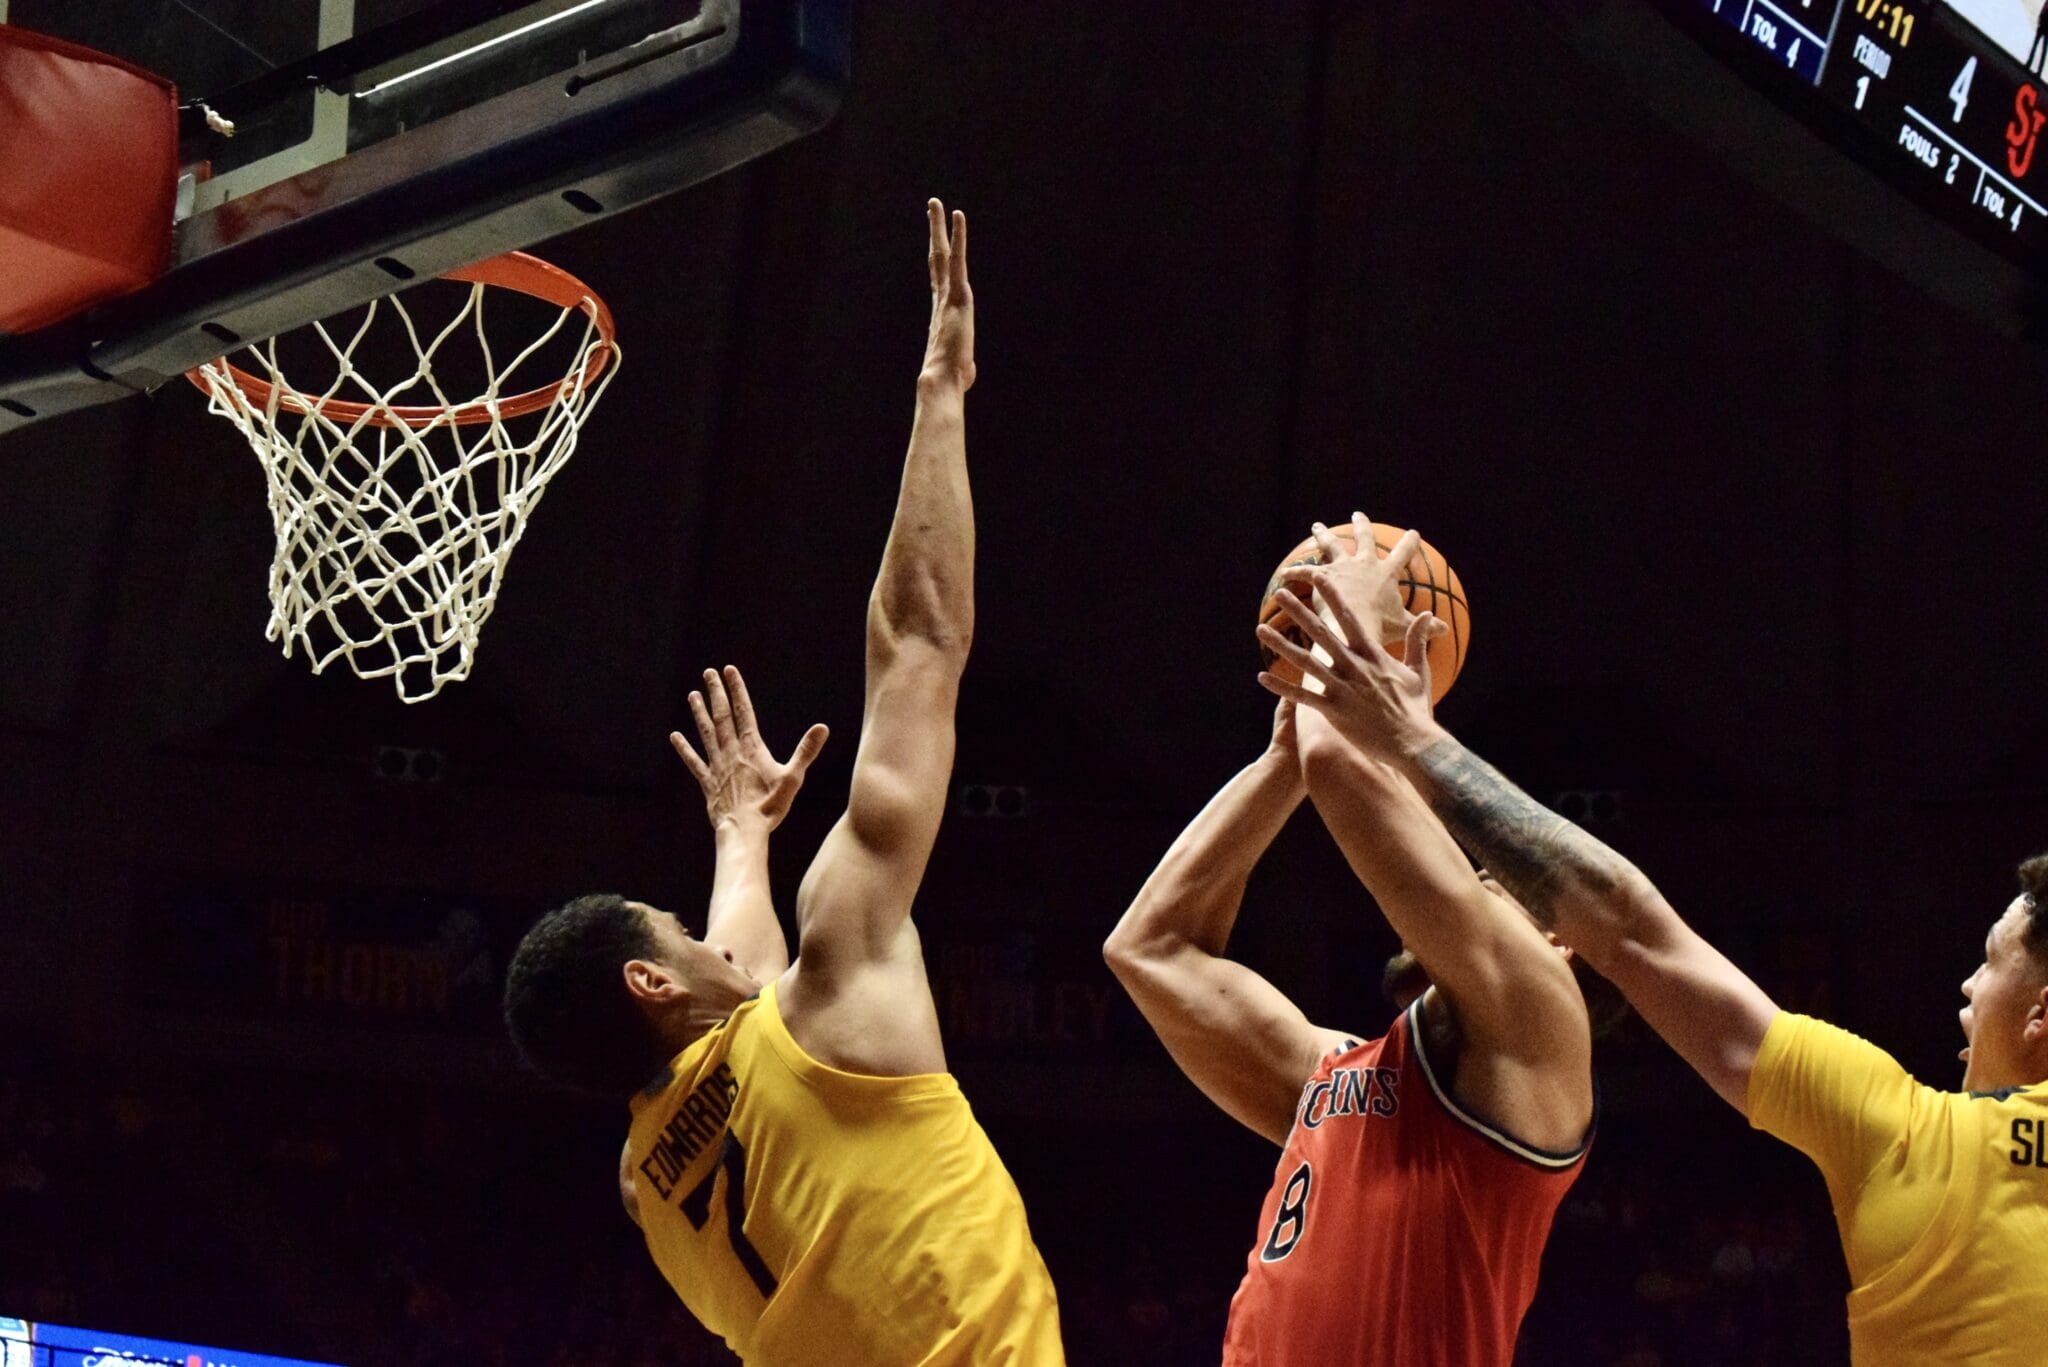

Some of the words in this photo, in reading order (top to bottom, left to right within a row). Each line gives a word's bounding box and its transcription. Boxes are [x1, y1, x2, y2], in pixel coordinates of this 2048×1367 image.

[1752, 14, 1777, 50] TOL
[1787, 38, 1801, 68] 4
[1853, 34, 1892, 80] PERIOD
[1855, 76, 1870, 110] 1
[1949, 56, 1977, 123] 4
[1899, 124, 1940, 168] FOULS
[1945, 154, 1960, 185] 2
[1983, 186, 2005, 219] TOL
[2010, 203, 2024, 232] 4
[269, 937, 449, 1011] THORN
[640, 1062, 739, 1201] EDWARDS
[2010, 1118, 2048, 1169] SL
[680, 1126, 779, 1300] 7
[1261, 1160, 1312, 1263] 8
